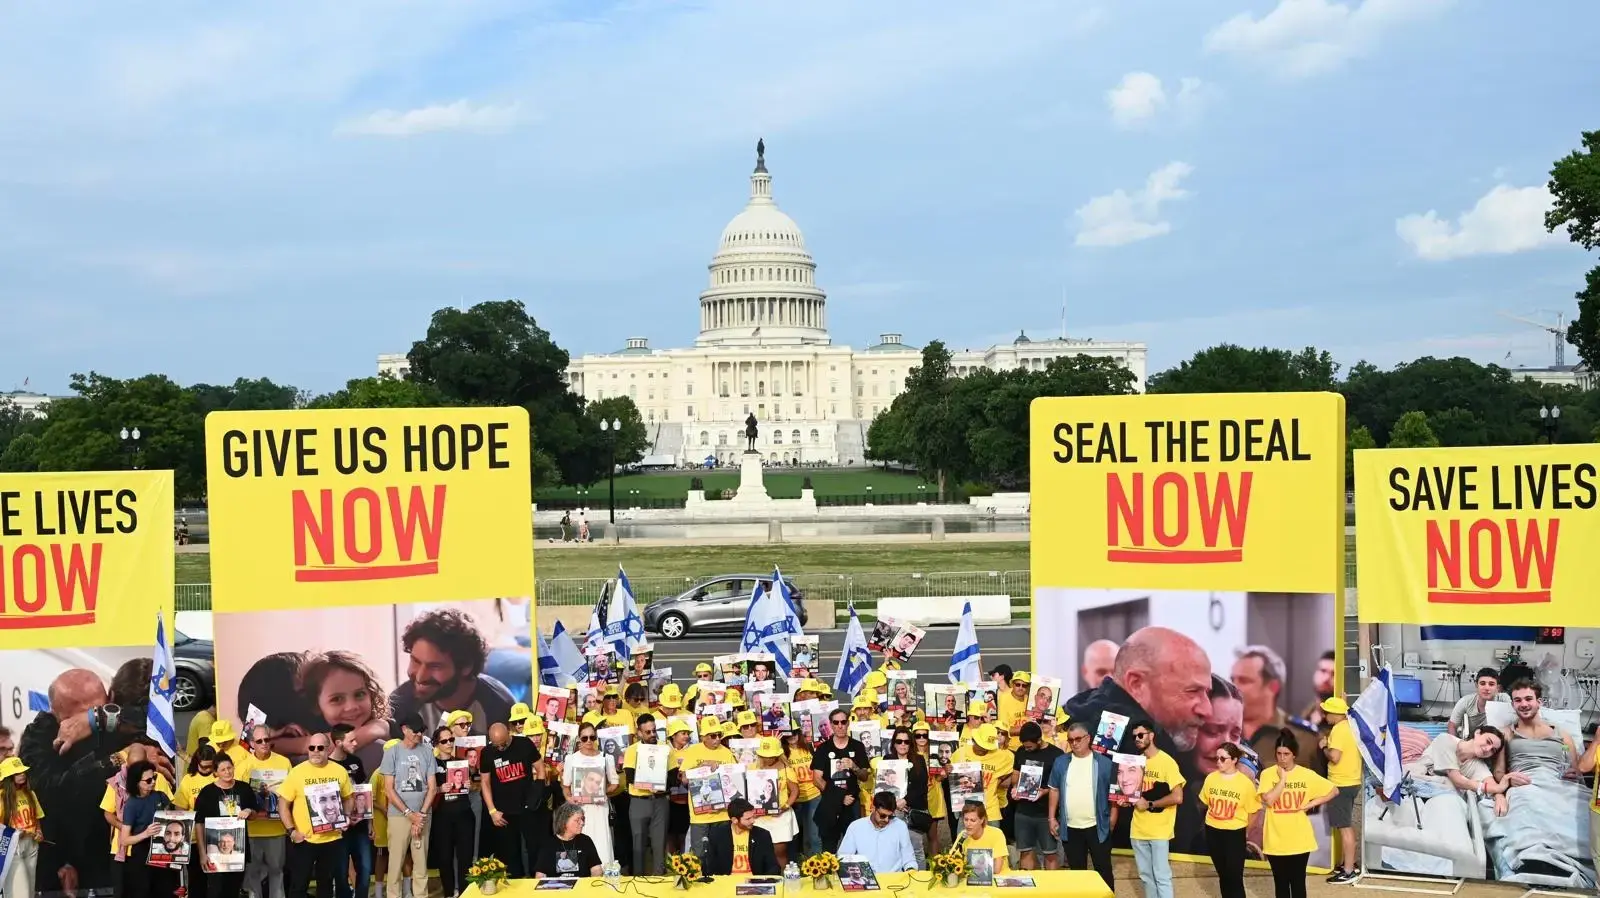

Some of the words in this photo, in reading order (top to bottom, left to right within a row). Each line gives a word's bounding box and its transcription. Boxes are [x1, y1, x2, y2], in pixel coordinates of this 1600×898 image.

[222, 429, 319, 478] GIVE
[334, 426, 388, 475] US
[403, 422, 510, 473] HOPE
[1053, 422, 1138, 463] SEAL
[1144, 421, 1210, 463] THE
[1219, 418, 1311, 462] DEAL
[1106, 471, 1254, 548] NOW
[1389, 466, 1479, 511] SAVE
[1491, 462, 1597, 510] LIVES
[34, 488, 138, 535] LIVES
[291, 484, 447, 566] NOW
[1426, 518, 1560, 590] NOW
[12, 686, 22, 719] 6
[495, 761, 526, 780] NOW!
[1209, 797, 1238, 816] NOW
[1228, 790, 1240, 800] DEAL
